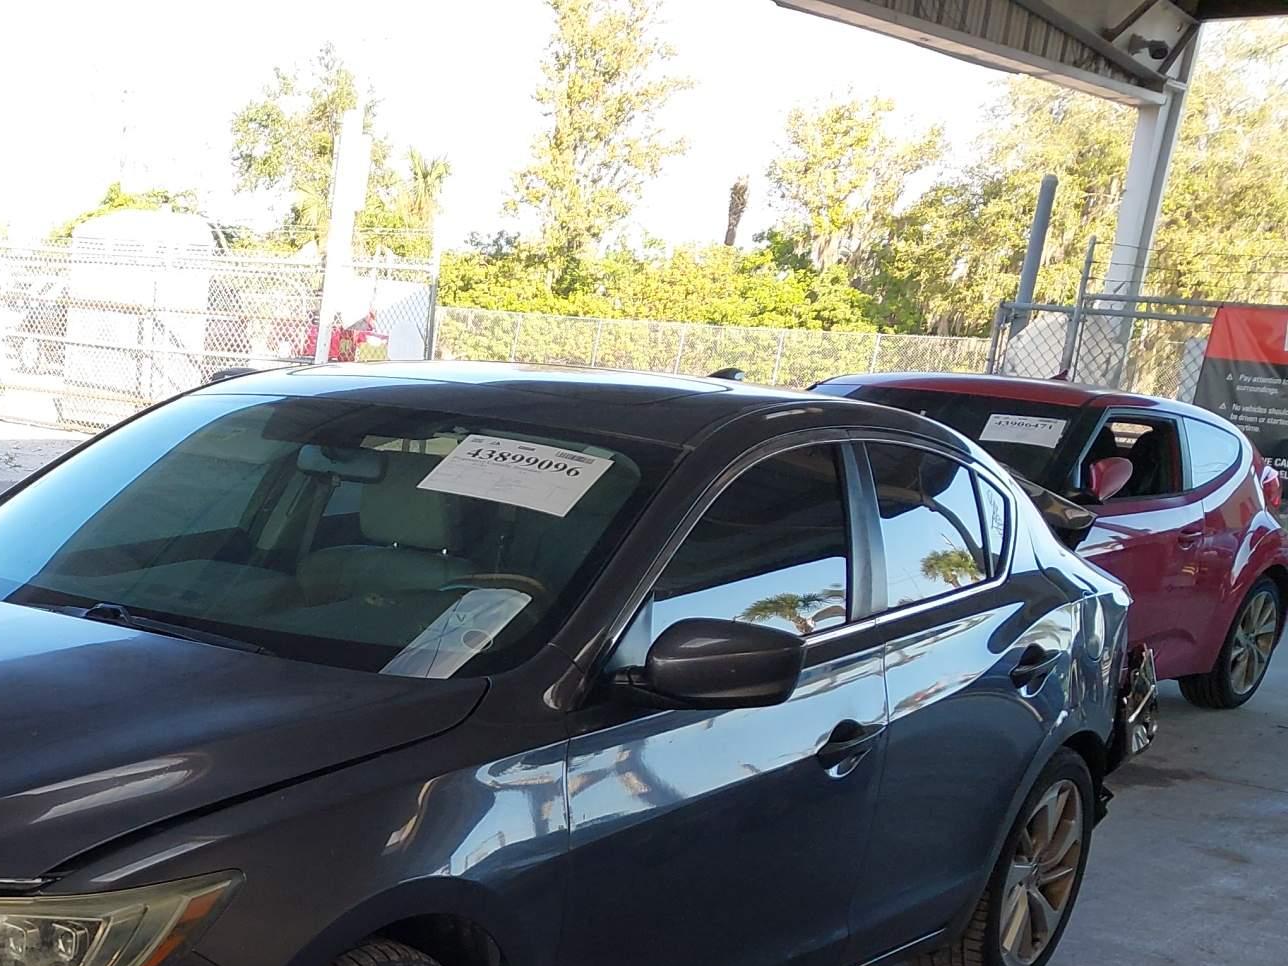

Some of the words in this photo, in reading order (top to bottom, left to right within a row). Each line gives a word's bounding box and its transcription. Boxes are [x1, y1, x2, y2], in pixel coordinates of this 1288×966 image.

[1239, 374, 1252, 383] Pay
[1232, 403, 1241, 411] No
[1242, 405, 1267, 414] vehicles
[467, 448, 583, 477] 43899096
